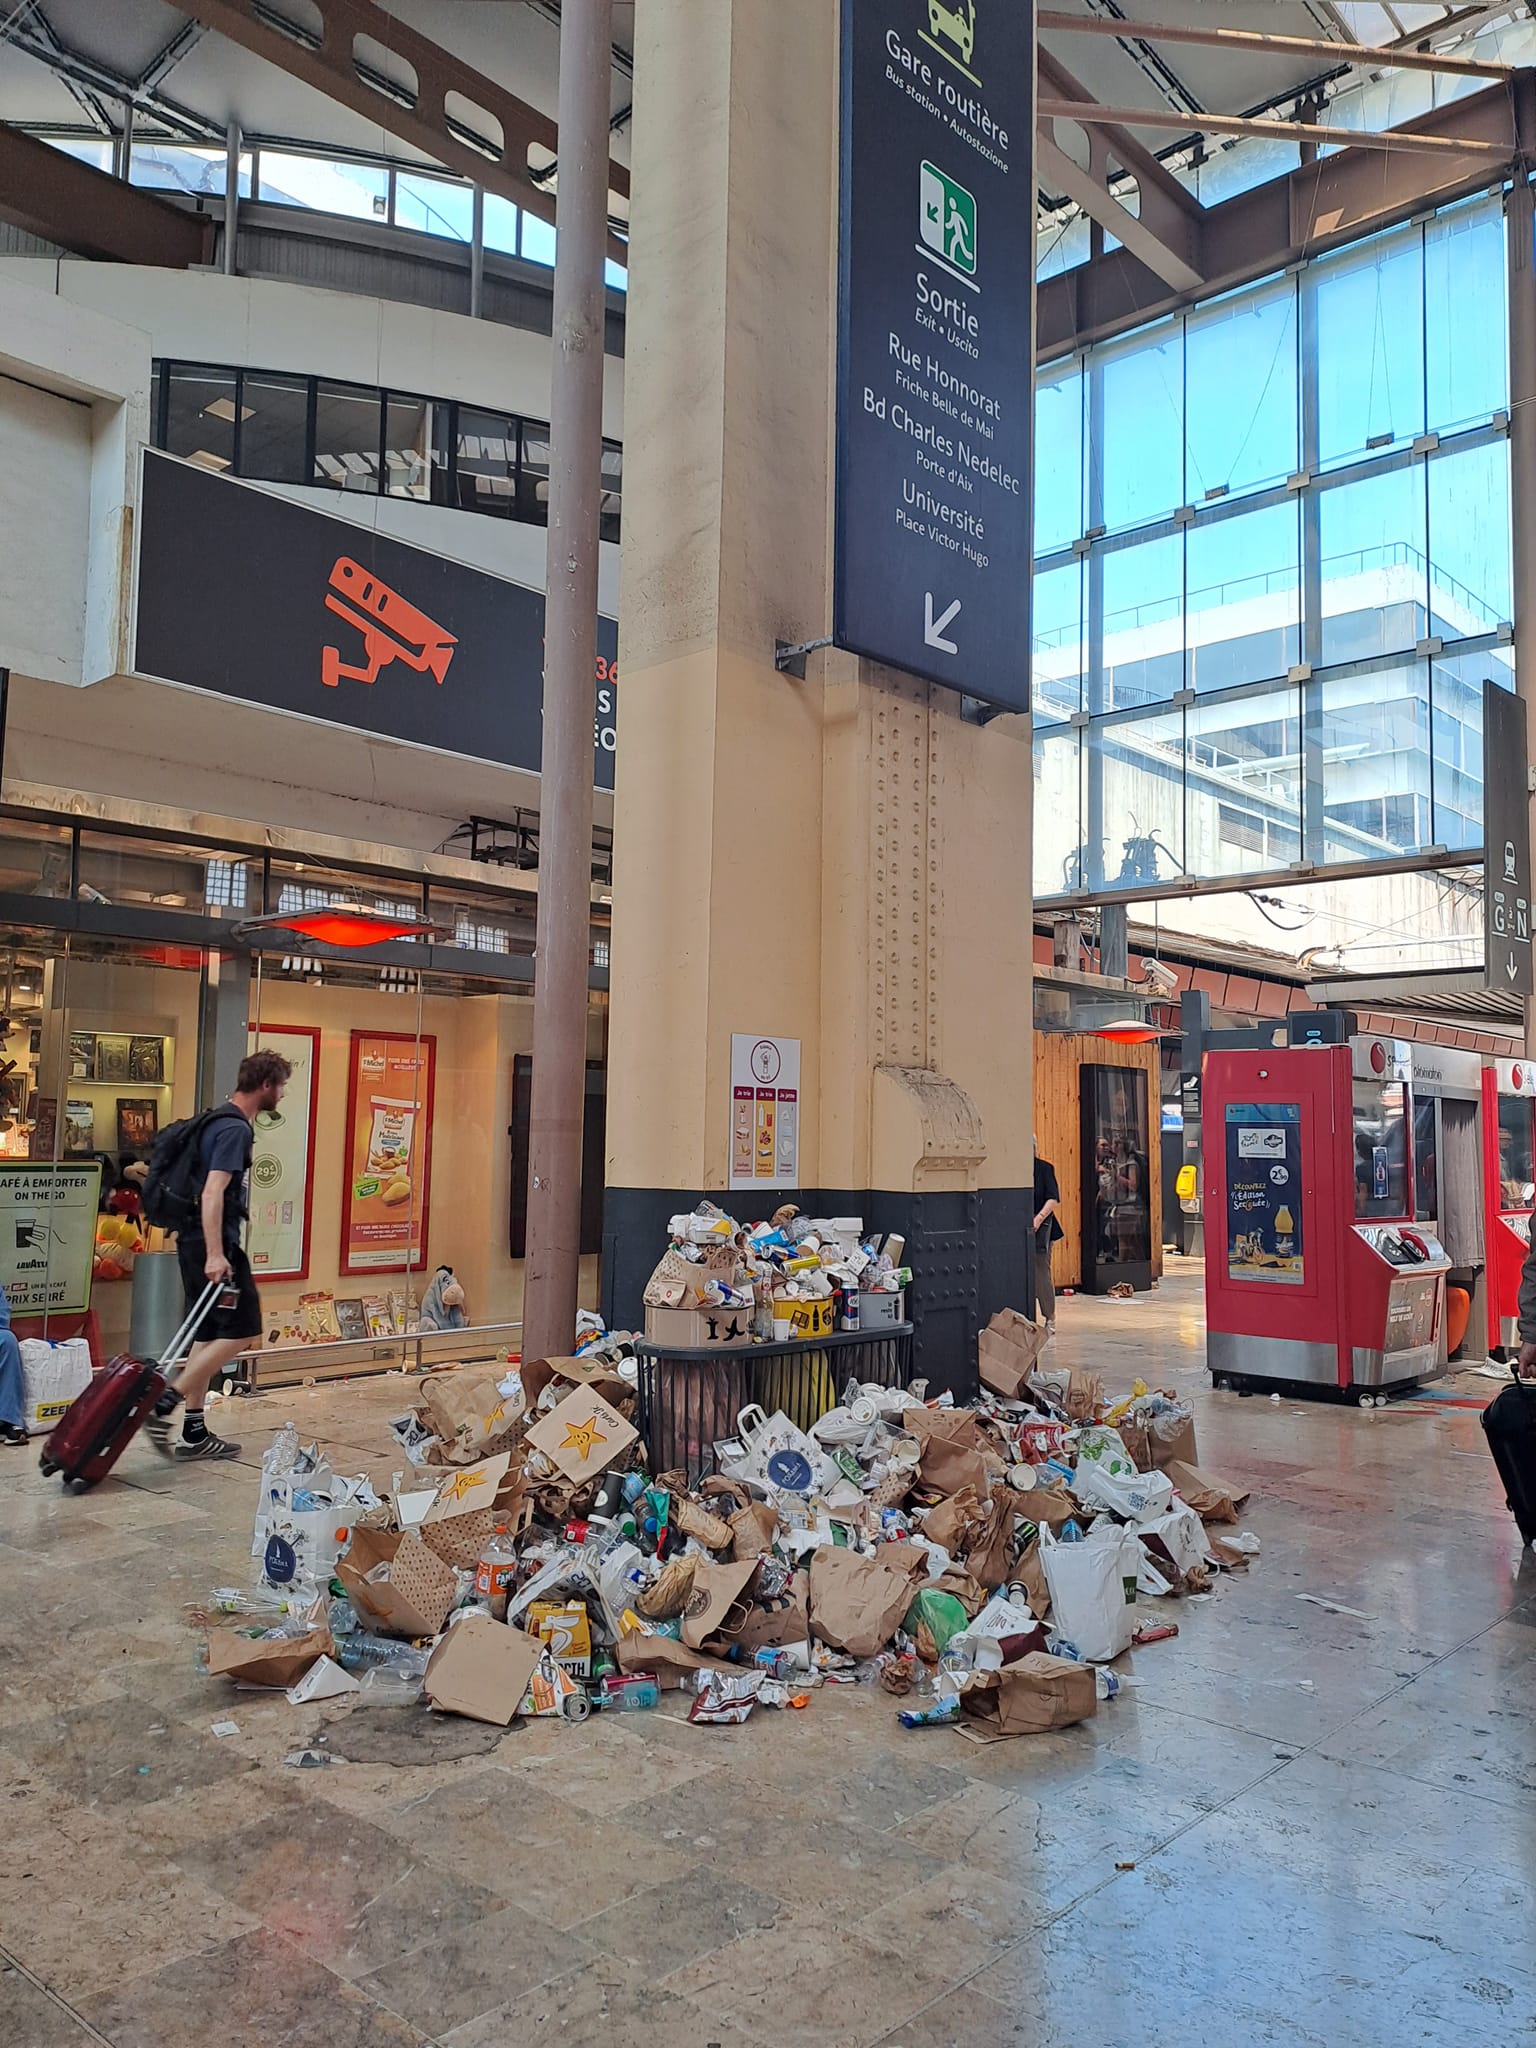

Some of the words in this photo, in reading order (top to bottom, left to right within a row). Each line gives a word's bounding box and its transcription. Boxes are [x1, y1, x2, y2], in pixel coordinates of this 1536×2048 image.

[886, 30, 932, 85] Gare
[938, 75, 1008, 150] routière
[886, 65, 904, 90] Bus
[906, 82, 940, 120] station
[950, 118, 1008, 174] Autostazione
[916, 273, 979, 338] Sortie
[916, 309, 936, 332] Exit
[948, 328, 980, 358] Uscita
[889, 332, 921, 372] Rue
[926, 356, 1001, 420] Honnorat
[896, 370, 930, 401] Friche
[932, 389, 959, 420] Belle
[960, 409, 974, 428] de
[976, 418, 994, 440] Mai
[864, 387, 886, 421] Bd
[892, 404, 953, 456] Charles
[958, 442, 1019, 495] Nedelec
[916, 450, 945, 479] Porte
[948, 468, 974, 494] d'Aix
[896, 508, 925, 536] Place
[928, 523, 960, 552] Victor
[962, 541, 989, 568] Hugo
[903, 478, 984, 539] Université
[1495, 905, 1505, 931] G
[1517, 910, 1527, 937] N
[0, 1177, 21, 1188] AFÉ
[15, 1192, 28, 1200] ON
[32, 1192, 50, 1200] THE
[41, 1404, 70, 1417] ZEE
